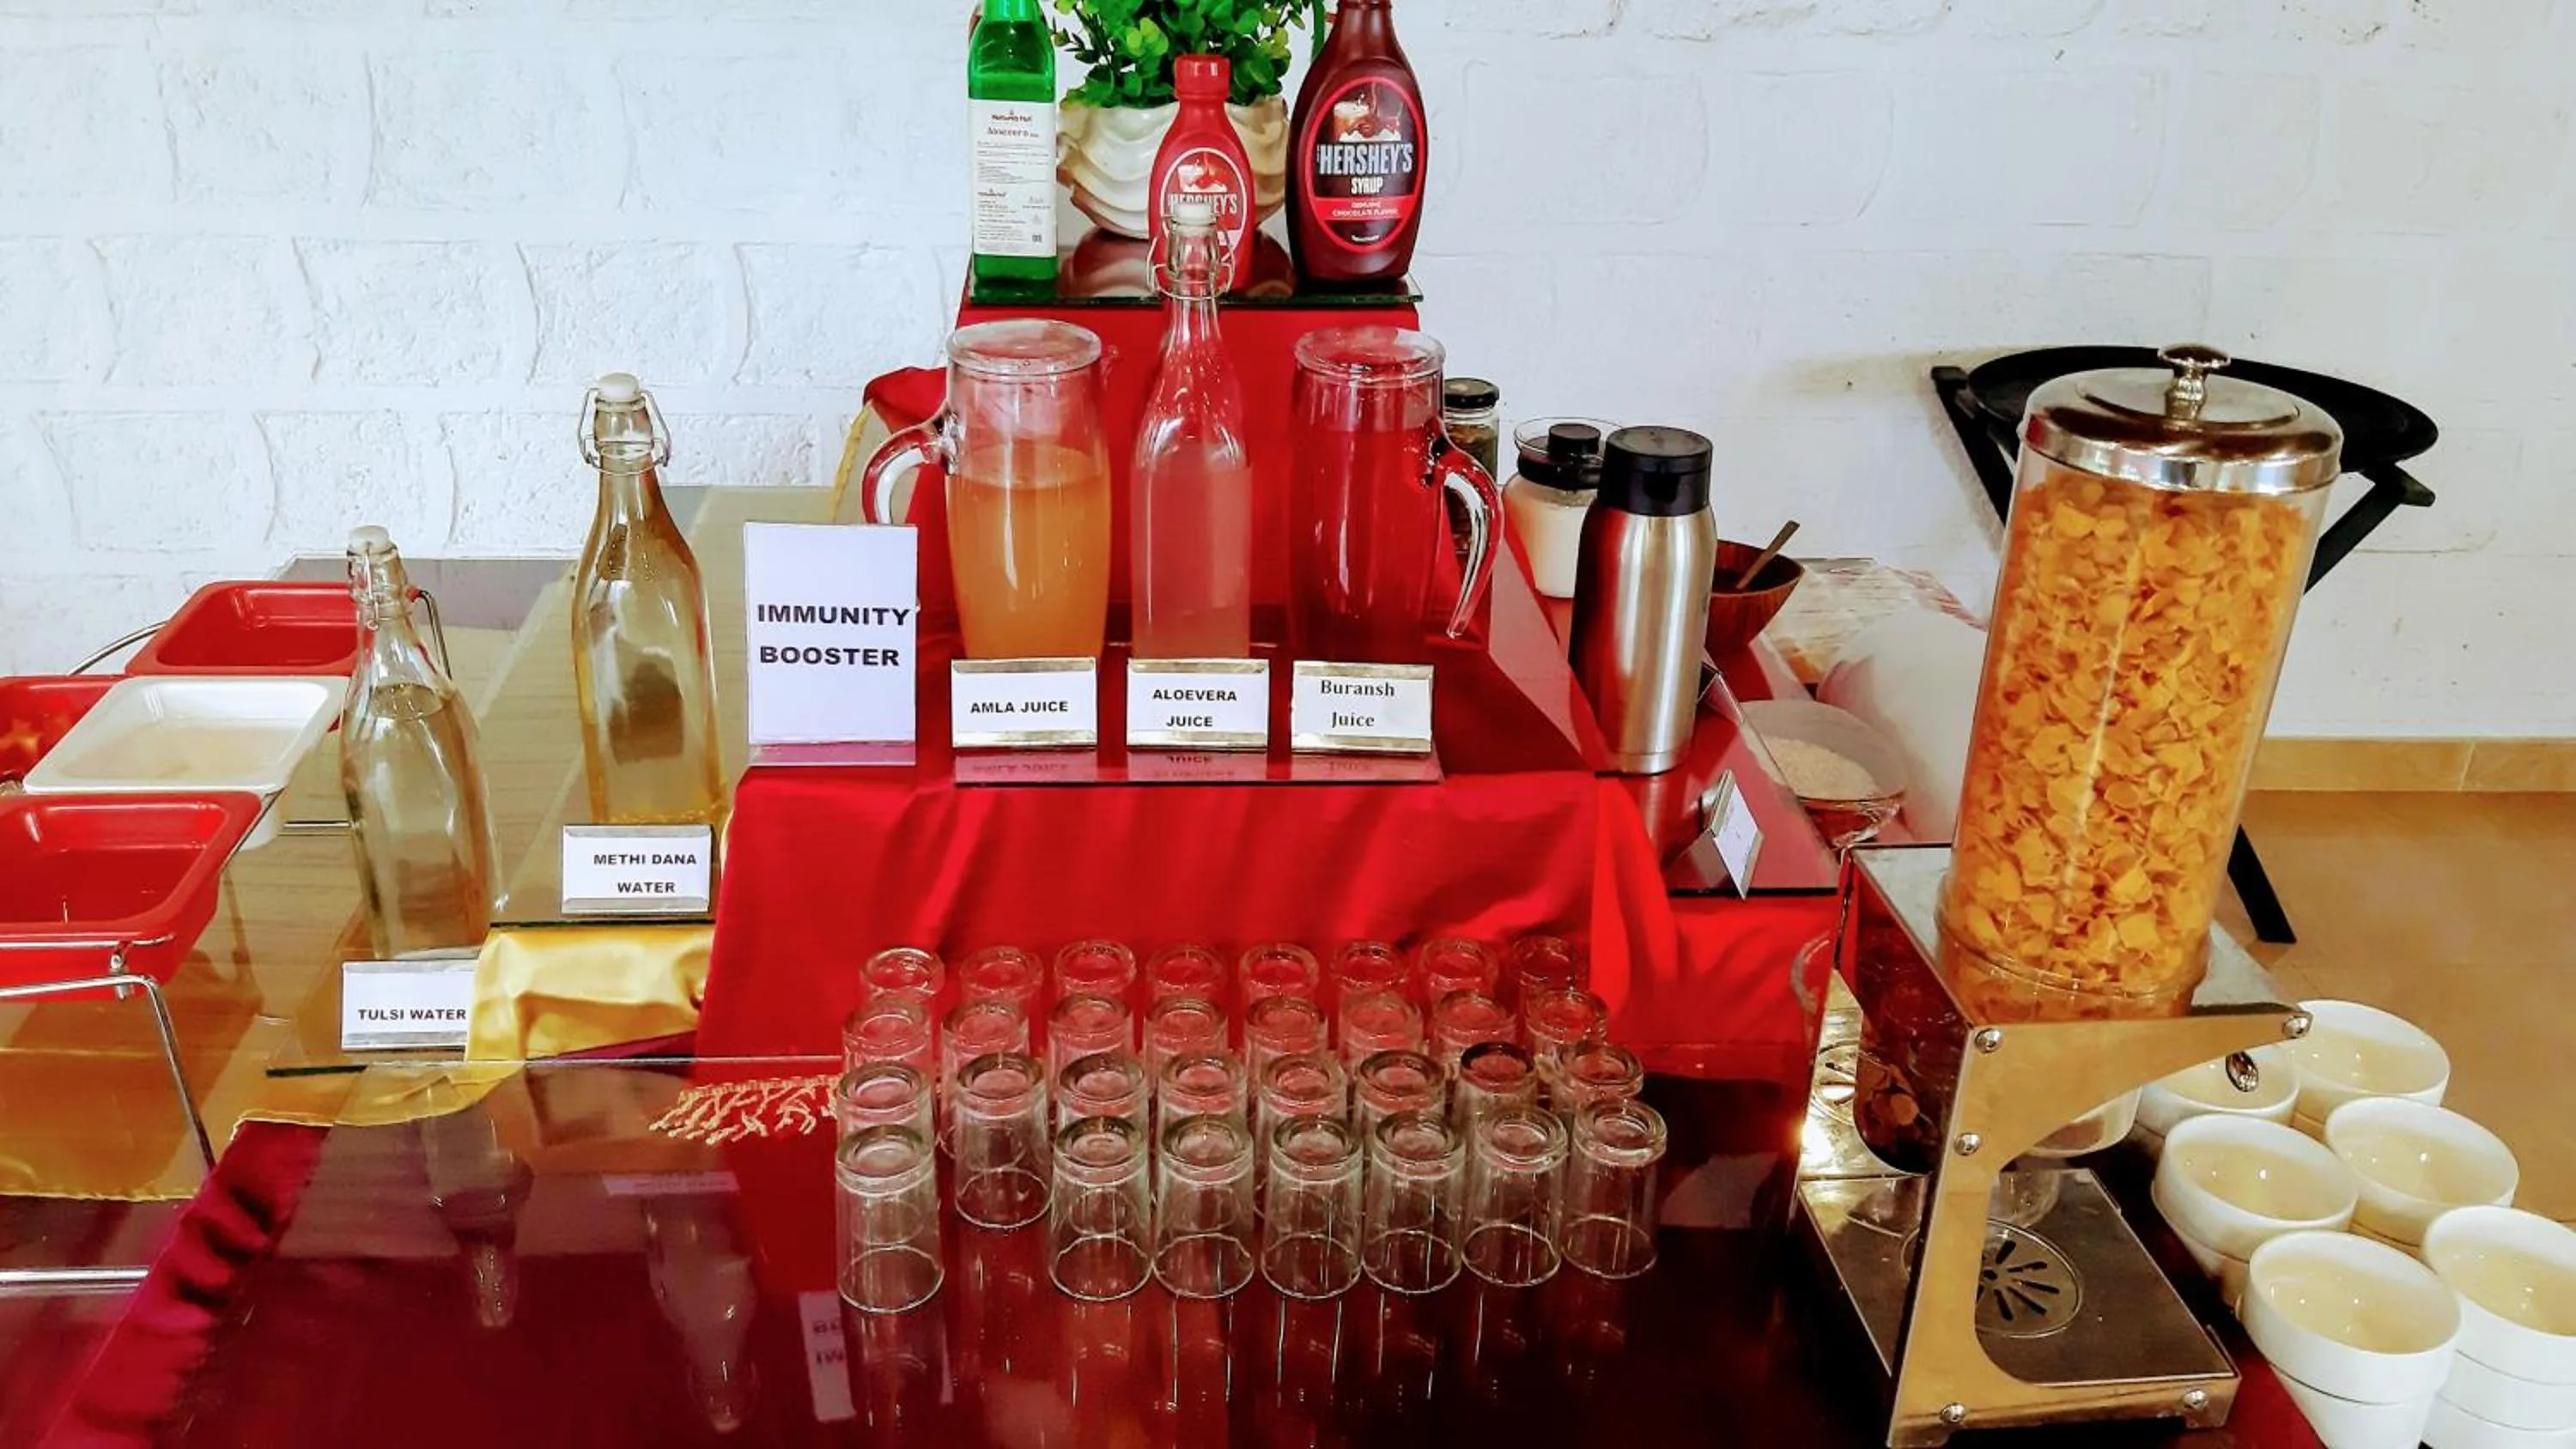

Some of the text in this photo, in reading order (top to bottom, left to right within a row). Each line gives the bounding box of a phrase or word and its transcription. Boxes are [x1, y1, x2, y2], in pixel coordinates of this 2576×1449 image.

[1320, 143, 1413, 175] HERSHEY'S
[1351, 177, 1383, 195] SYRUP
[757, 604, 910, 626] IMMUNITY
[760, 646, 900, 666] BOOSTER
[1152, 689, 1237, 701] ALOEVERA
[1320, 679, 1395, 697] Buransh
[970, 700, 1068, 713] AMLA JUICE
[1165, 716, 1213, 727] JUICE
[1330, 712, 1375, 728] Juice
[593, 854, 697, 865] METHI DANA
[617, 882, 675, 894] WATER
[357, 1009, 466, 1020] TULSI WATER
